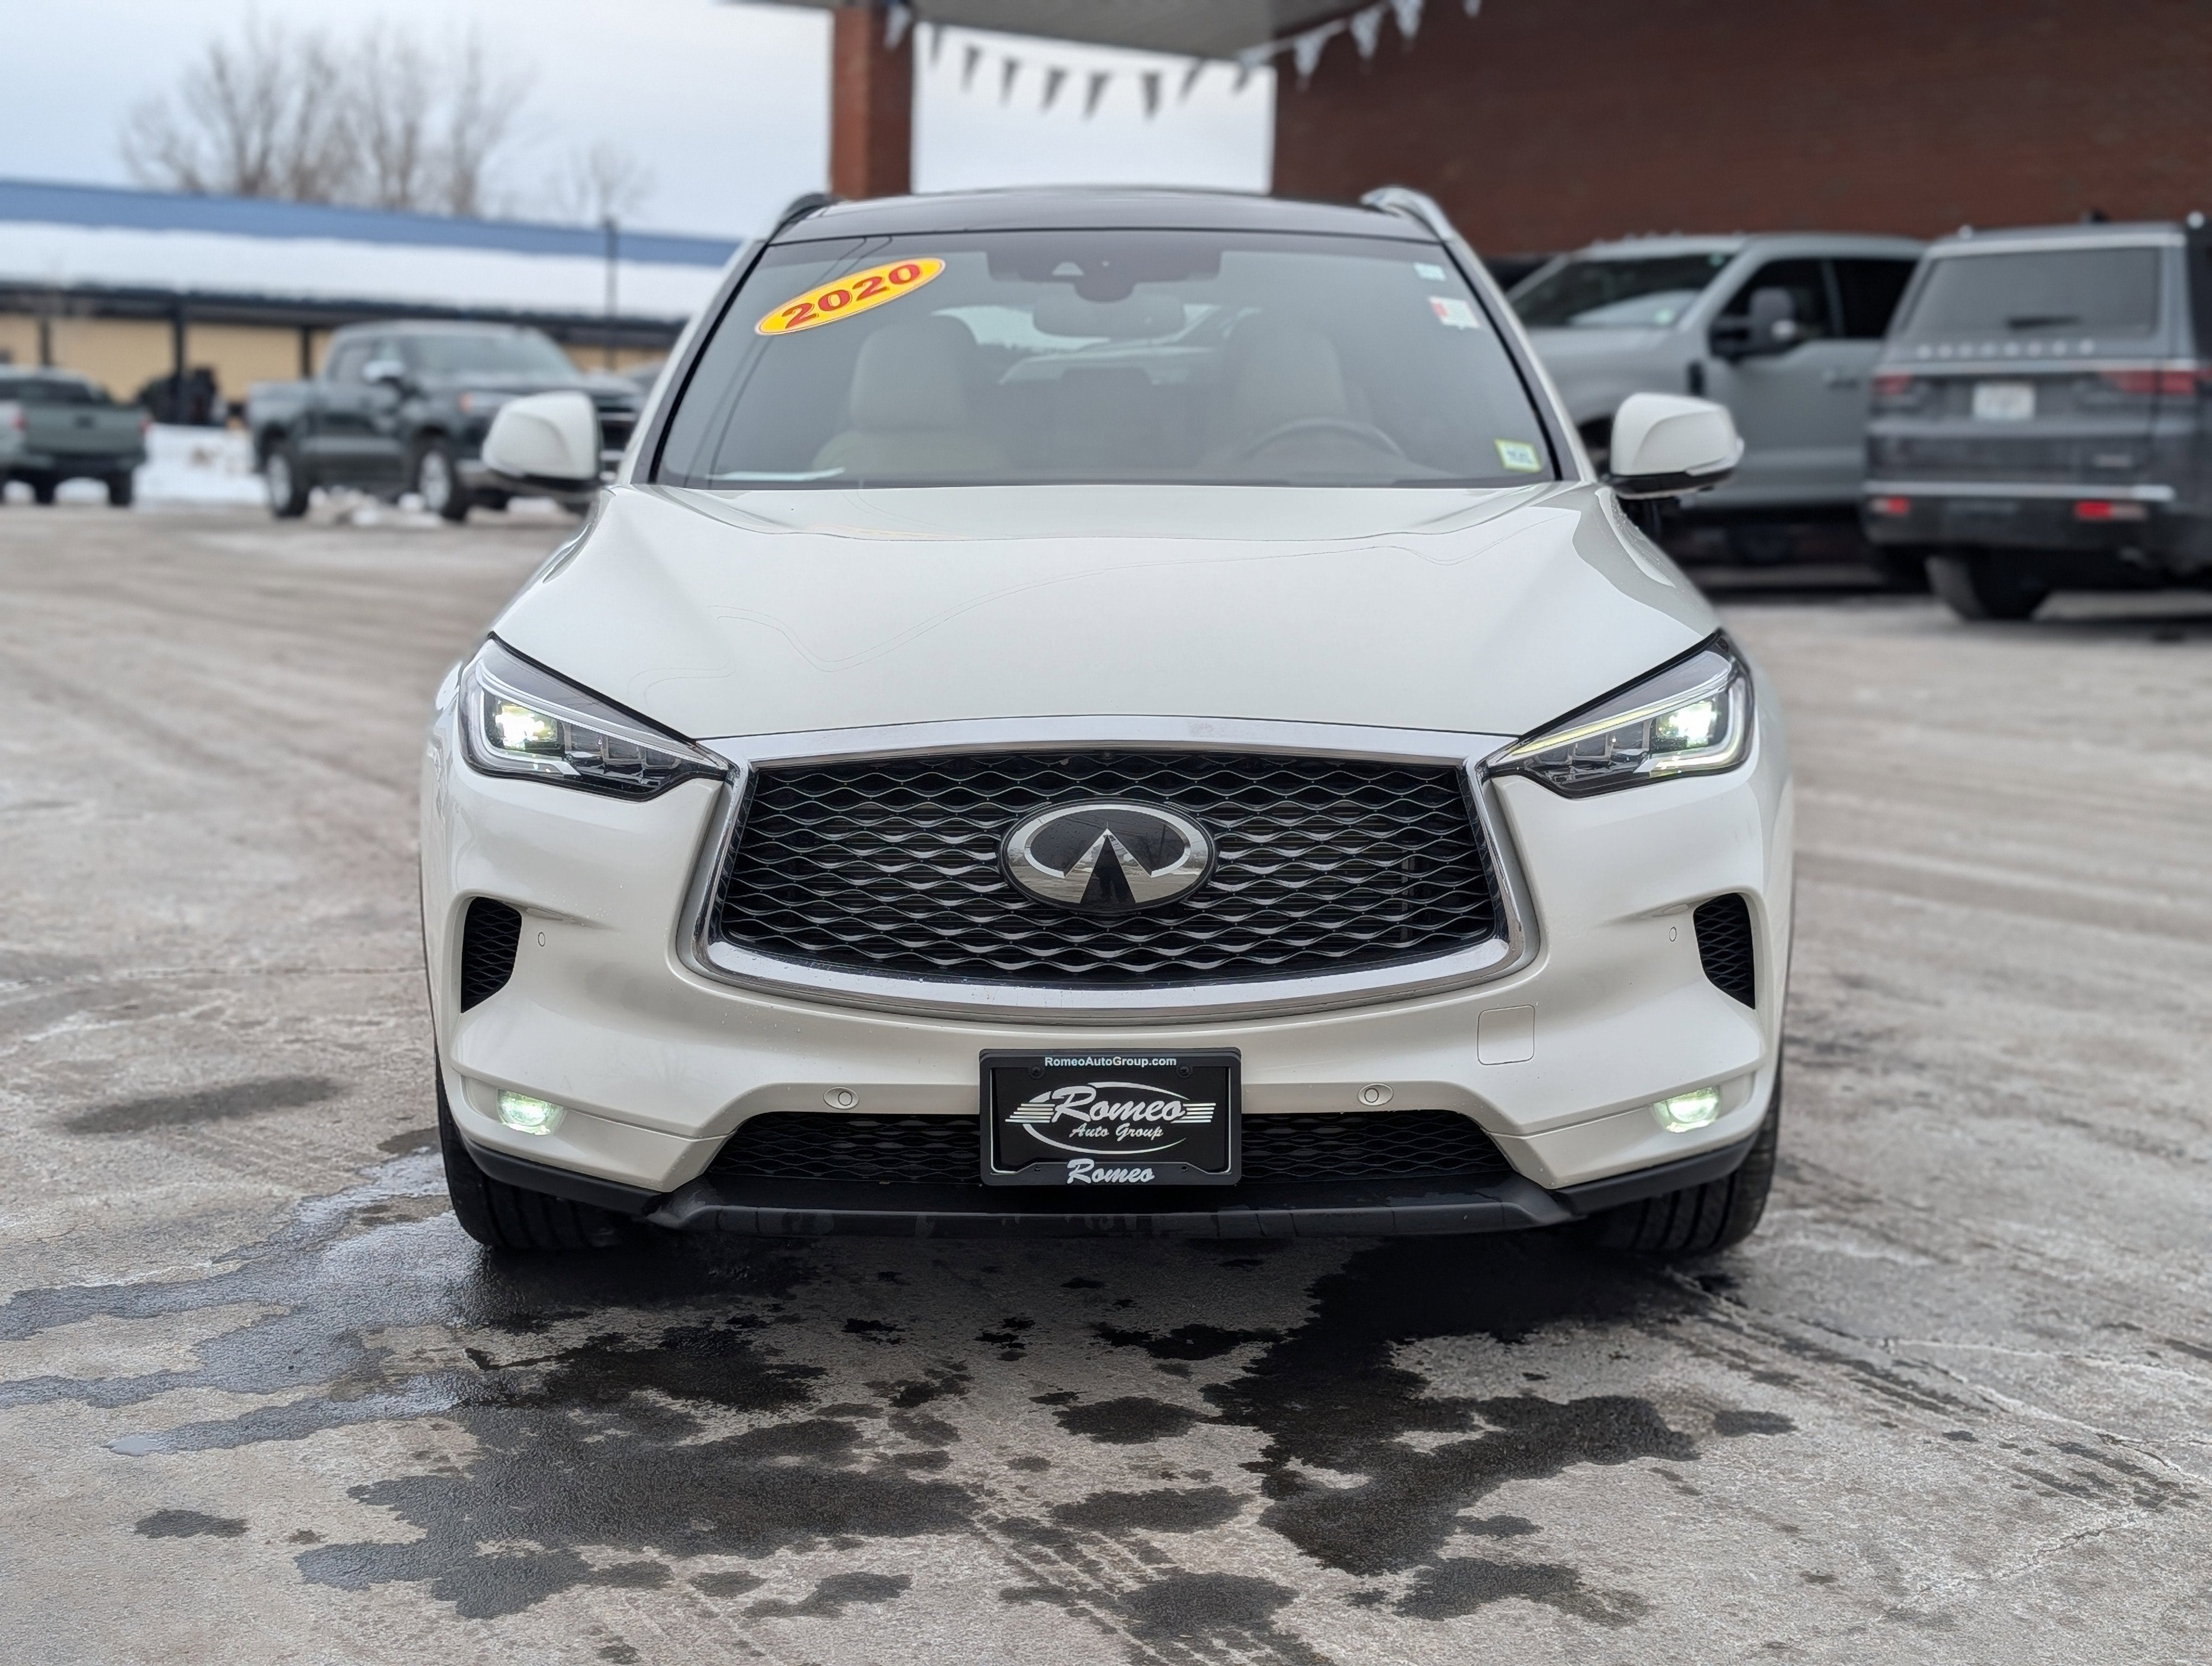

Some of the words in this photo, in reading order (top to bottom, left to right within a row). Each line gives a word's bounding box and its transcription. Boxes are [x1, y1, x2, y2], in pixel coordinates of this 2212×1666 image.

[781, 264, 922, 329] 2020
[1045, 1056, 1176, 1067] RomeoAutoGroup.com
[1051, 1086, 1186, 1123] Romeo
[1069, 1123, 1109, 1138] Auto
[1115, 1123, 1163, 1142] Group
[1067, 1158, 1155, 1184] Romeo
